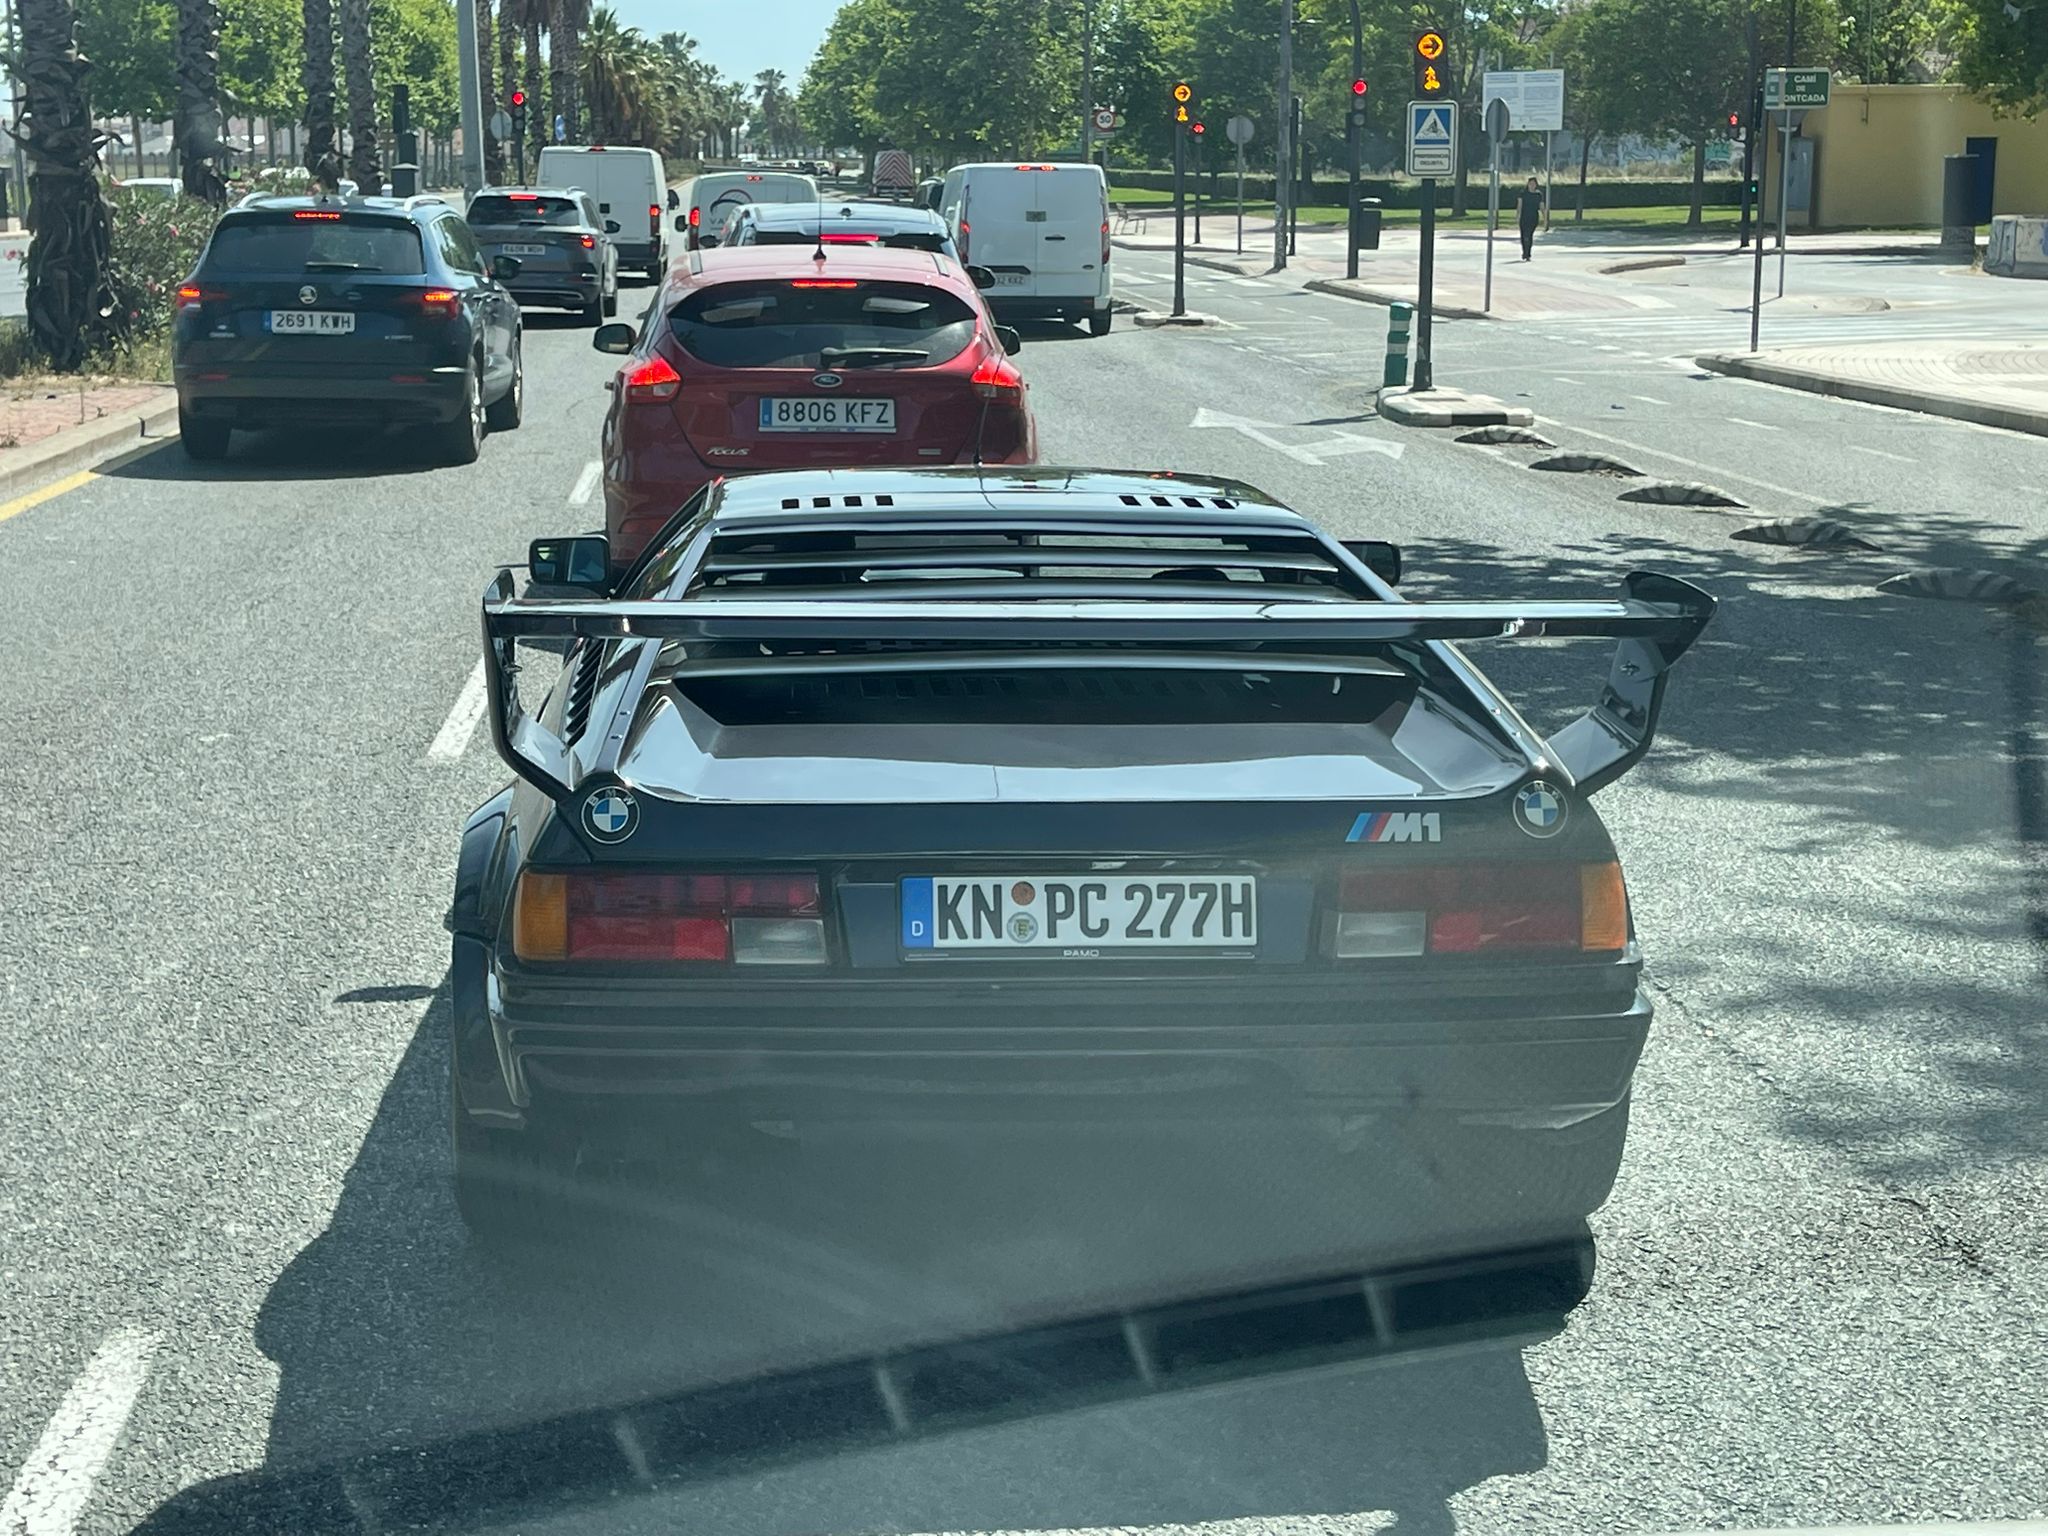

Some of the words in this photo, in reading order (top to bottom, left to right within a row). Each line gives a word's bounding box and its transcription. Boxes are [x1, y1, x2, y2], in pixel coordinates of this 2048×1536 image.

[1783, 94, 1826, 103] ONTCADA
[1099, 115, 1111, 124] 50
[276, 314, 315, 328] 2691
[320, 315, 351, 328] KWH
[777, 401, 837, 423] 8806
[845, 402, 889, 424] KFZ
[1377, 812, 1442, 843] M1
[937, 884, 1003, 940] KN
[1044, 883, 1110, 939] PC
[1124, 882, 1253, 939] 277H
[911, 920, 924, 937] D
